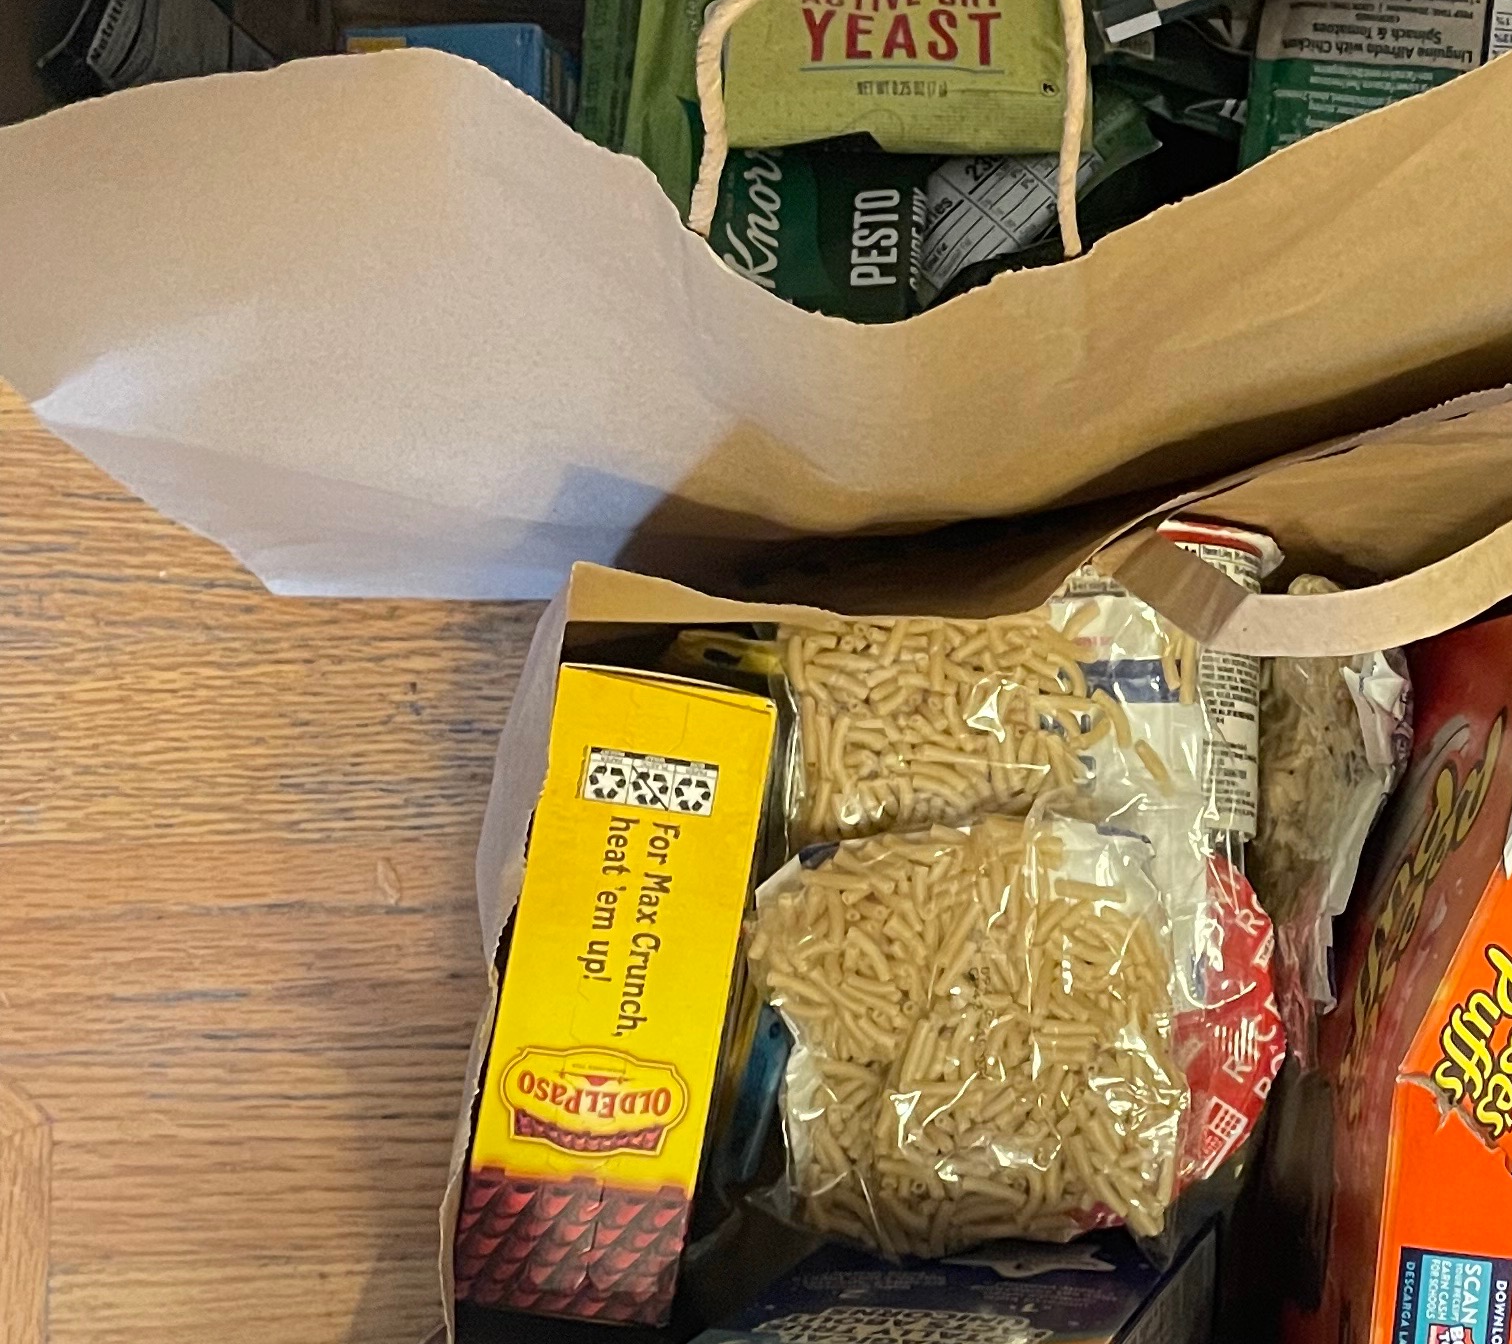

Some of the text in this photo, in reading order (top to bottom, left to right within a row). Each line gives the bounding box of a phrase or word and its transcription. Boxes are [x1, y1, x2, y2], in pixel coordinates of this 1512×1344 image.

[802, 8, 1002, 66] YEAST
[1335, 41, 1365, 56] with
[1366, 45, 1414, 59] Alfredo
[1378, 28, 1391, 41] &
[1417, 47, 1472, 64] Linguine
[723, 156, 782, 288] Knor
[850, 189, 900, 286] PESTO
[602, 816, 640, 876] heat
[610, 821, 681, 1037] For Max Crunch,
[577, 939, 612, 981] up!
[1401, 1261, 1415, 1327] DESCARGA
[1425, 1258, 1440, 1320] FOR SCHOOLS
[1437, 1260, 1452, 1321] EARN CASH
[1462, 1263, 1482, 1324] SCAN
